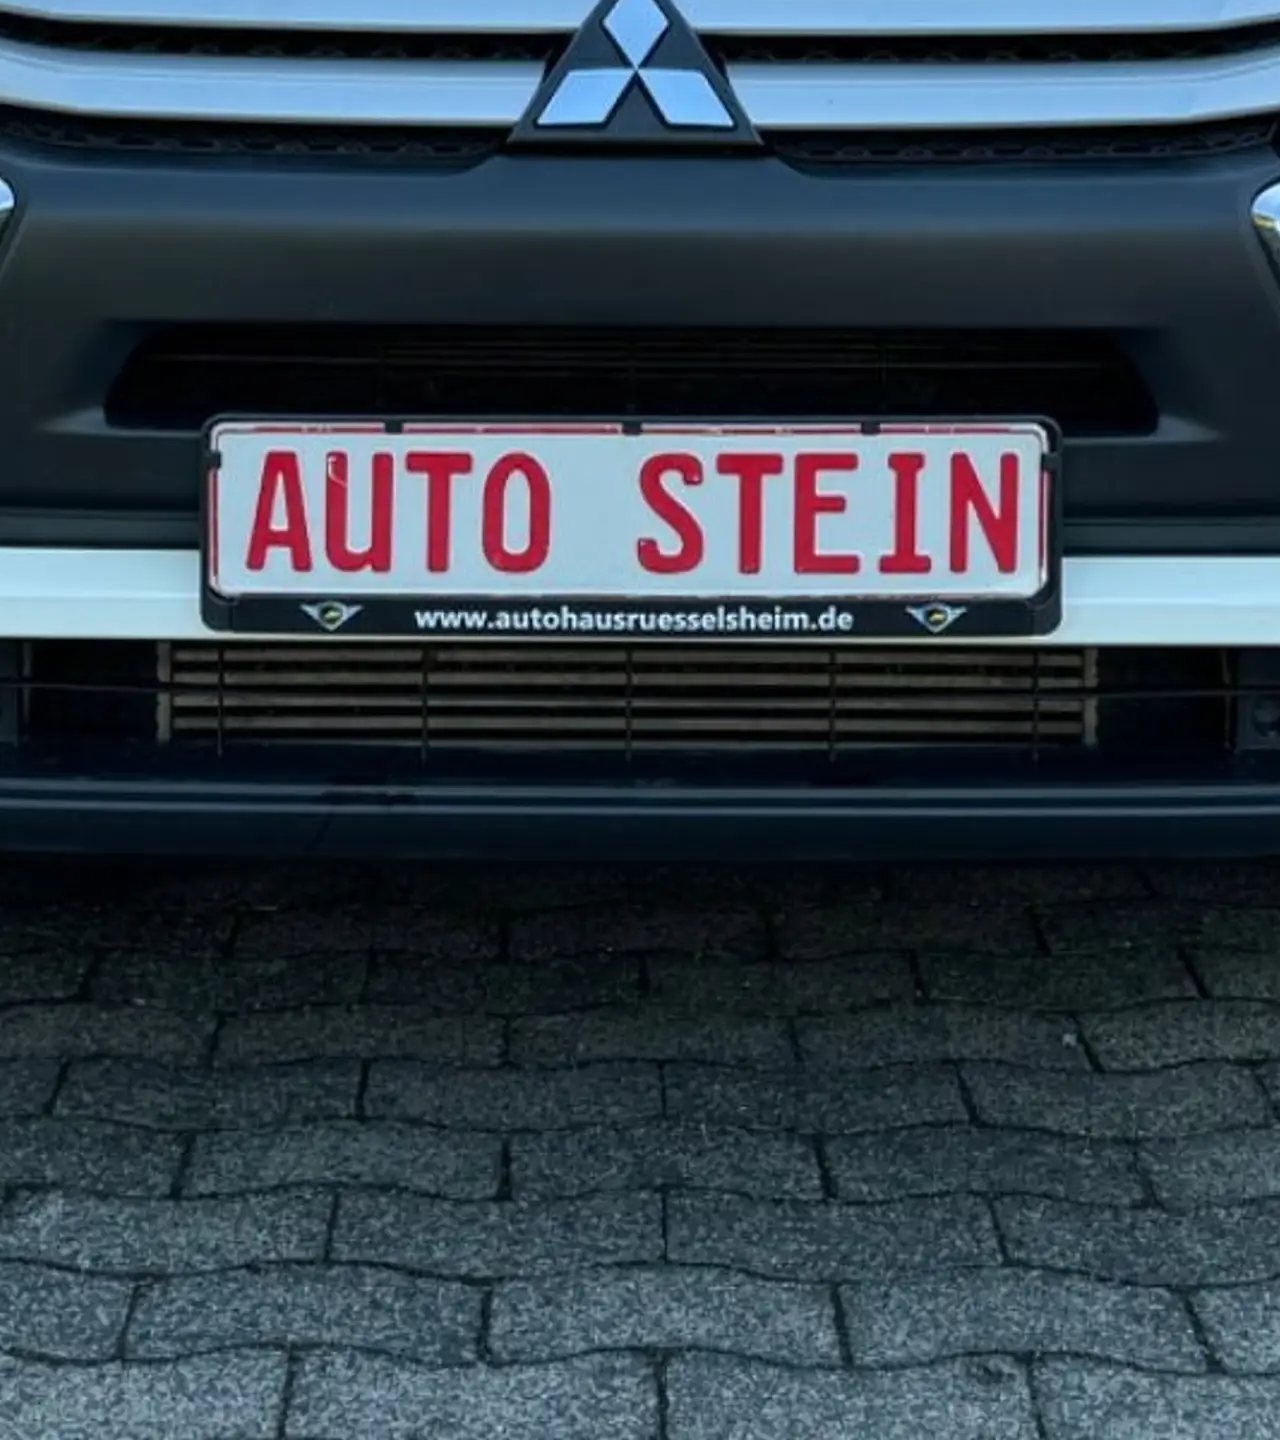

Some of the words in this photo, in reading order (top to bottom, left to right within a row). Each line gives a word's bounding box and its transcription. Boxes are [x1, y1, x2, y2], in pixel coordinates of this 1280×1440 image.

[245, 450, 552, 575] AUTO
[637, 451, 1019, 575] STEIN
[414, 604, 855, 632] www.autohausruesselsheim.de
